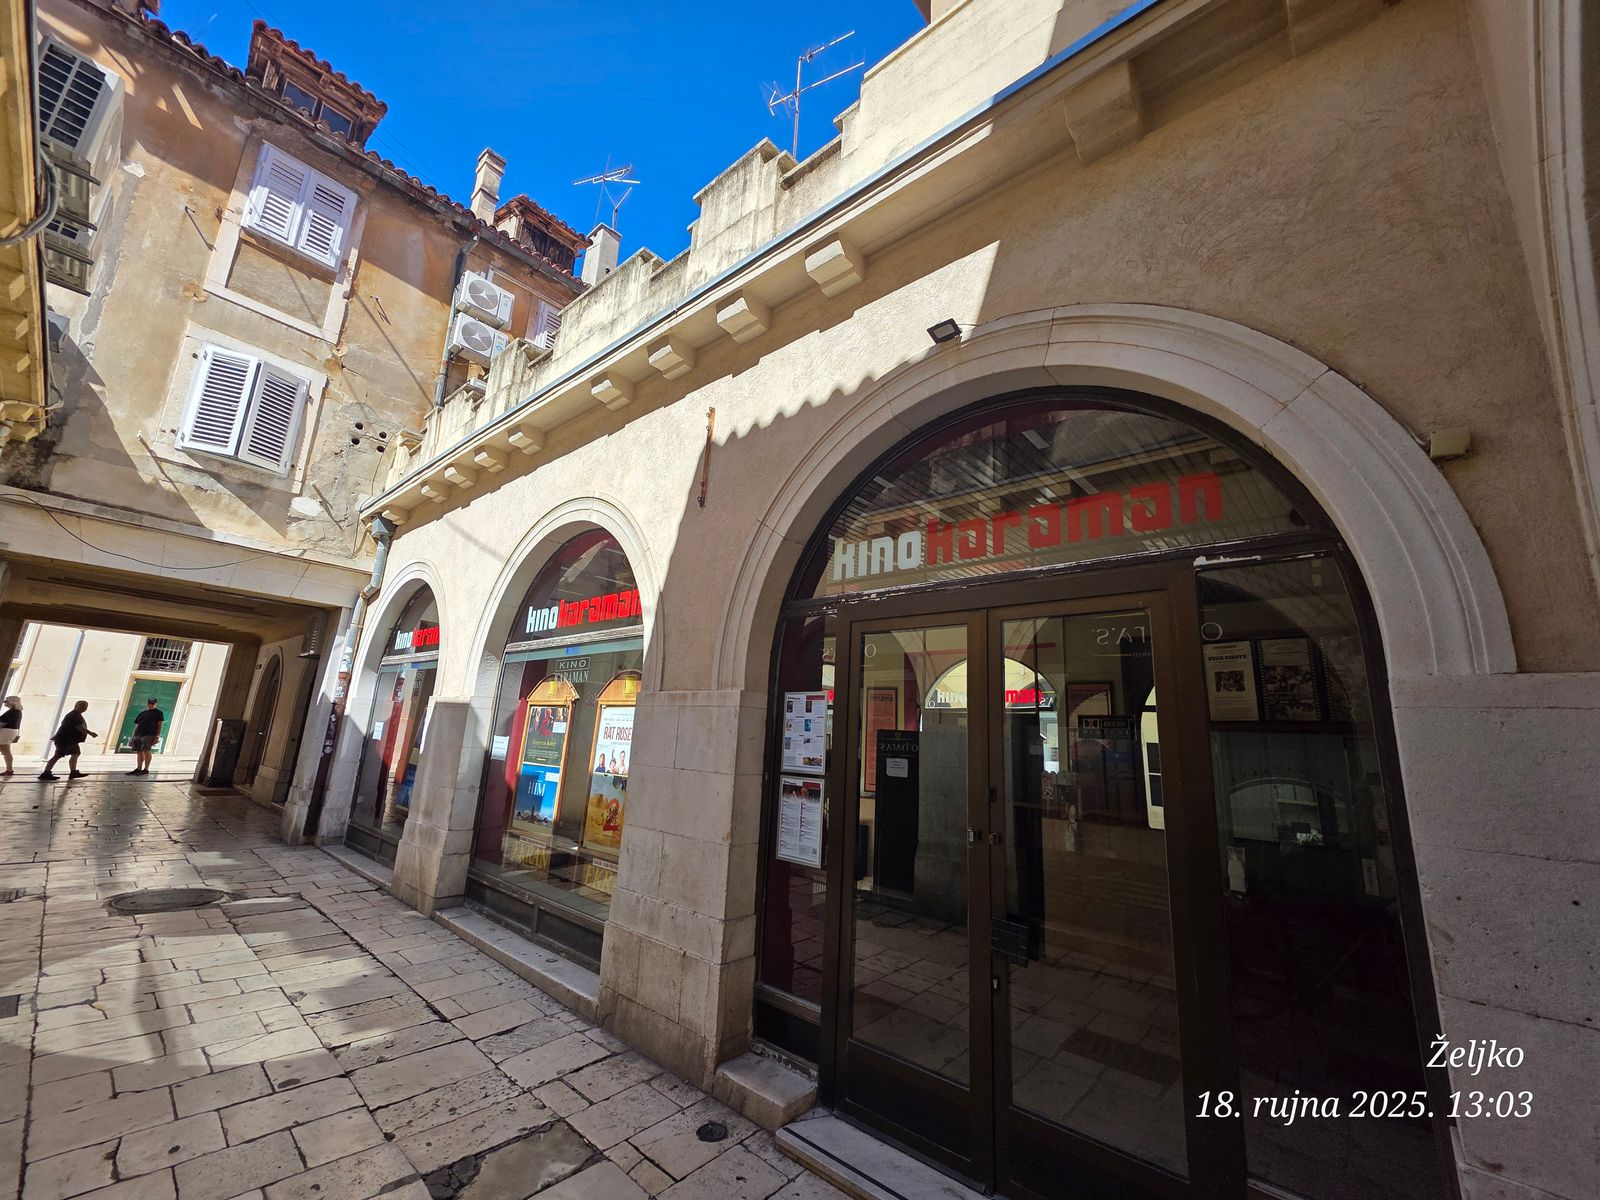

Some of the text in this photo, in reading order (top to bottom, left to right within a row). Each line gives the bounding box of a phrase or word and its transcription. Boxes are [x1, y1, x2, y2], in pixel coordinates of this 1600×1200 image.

[832, 472, 1224, 581] kino karaman
[526, 605, 559, 634] kino
[394, 630, 414, 651] kino
[559, 660, 588, 669] KINO
[527, 781, 546, 797] HIM
